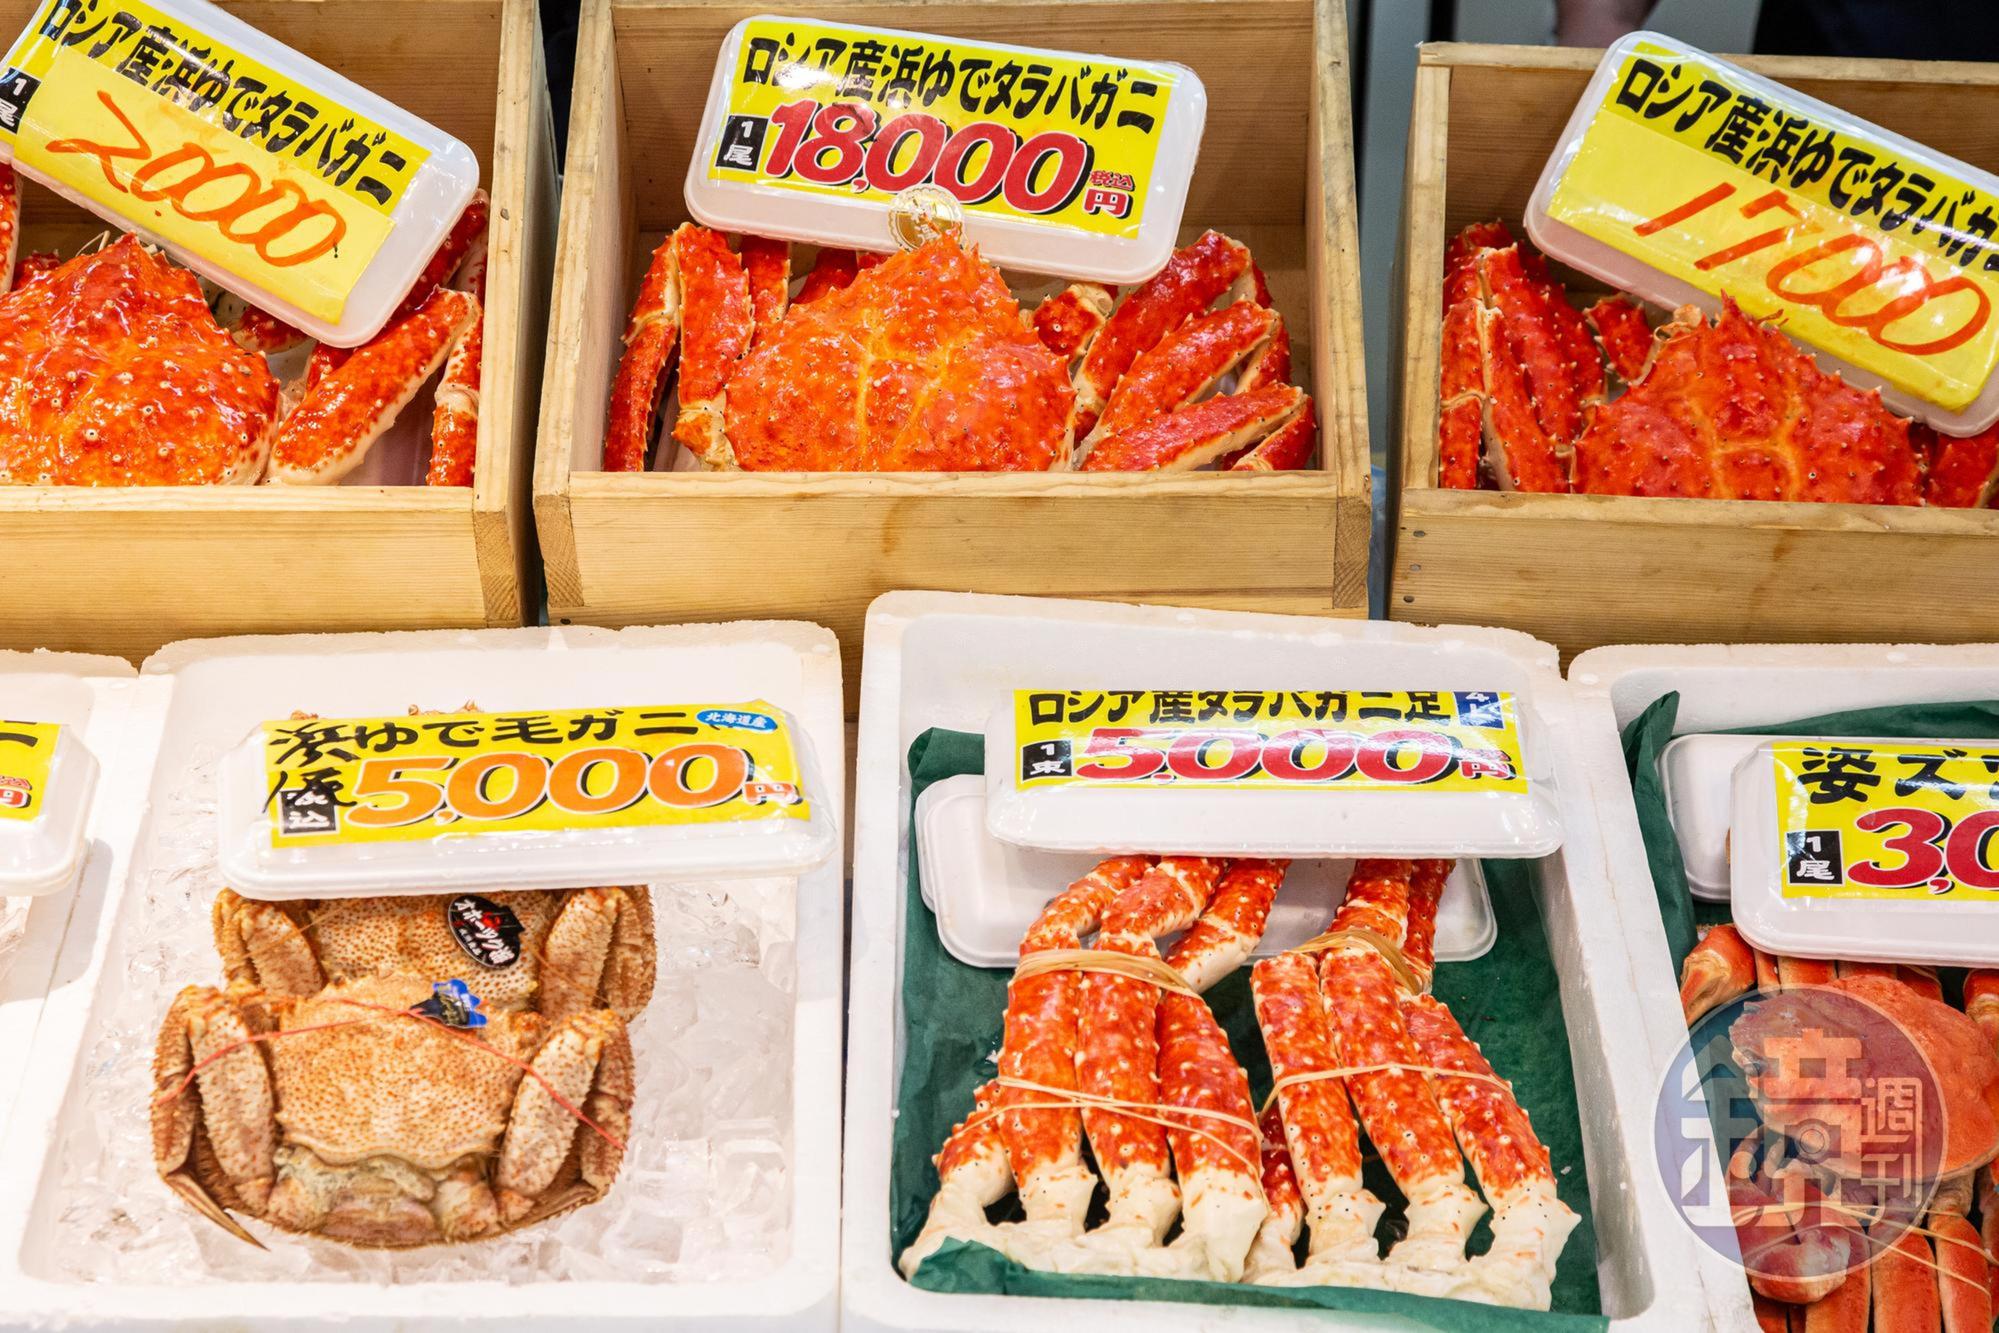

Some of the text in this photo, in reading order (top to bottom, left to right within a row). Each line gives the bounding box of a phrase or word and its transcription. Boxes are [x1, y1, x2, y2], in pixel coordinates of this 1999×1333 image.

[742, 31, 1158, 136] ロシア産浜ゆでタラバガニ
[722, 121, 753, 167] 1尾
[1797, 836, 1835, 881] 1尾
